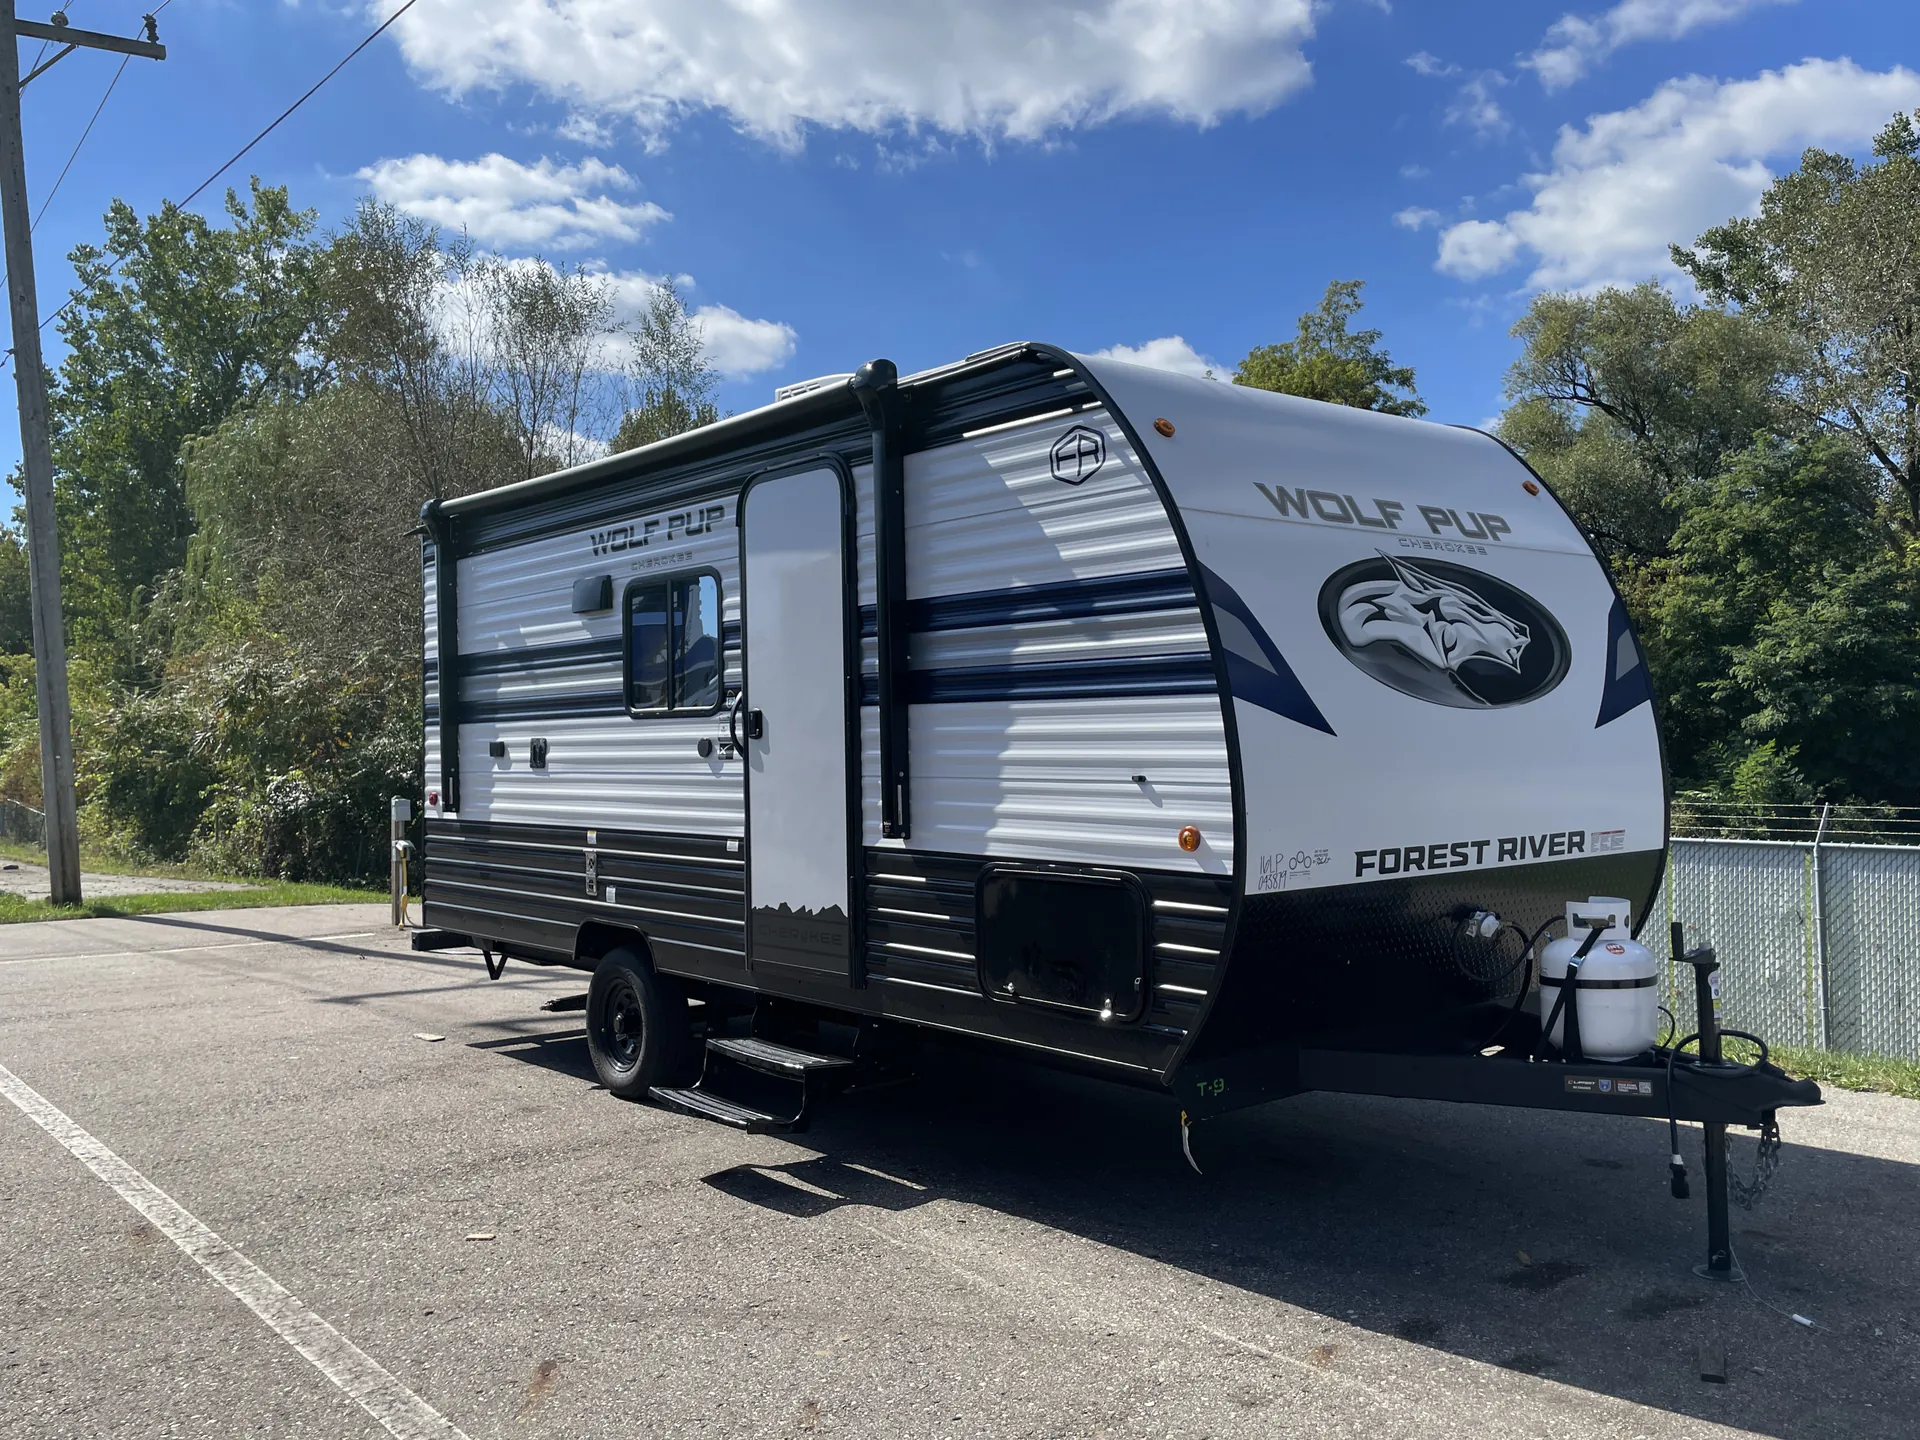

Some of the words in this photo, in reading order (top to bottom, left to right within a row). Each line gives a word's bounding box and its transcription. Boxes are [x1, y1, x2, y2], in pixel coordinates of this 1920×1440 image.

[589, 519, 660, 557] WOLF
[667, 504, 726, 541] PUP
[1252, 481, 1405, 530] WOLF
[1416, 504, 1512, 542] PUP
[631, 551, 693, 571] CHEROKEE
[1398, 537, 1488, 556] CHEROKEE
[1354, 839, 1491, 878] FOREST
[1496, 830, 1586, 863] RIVER
